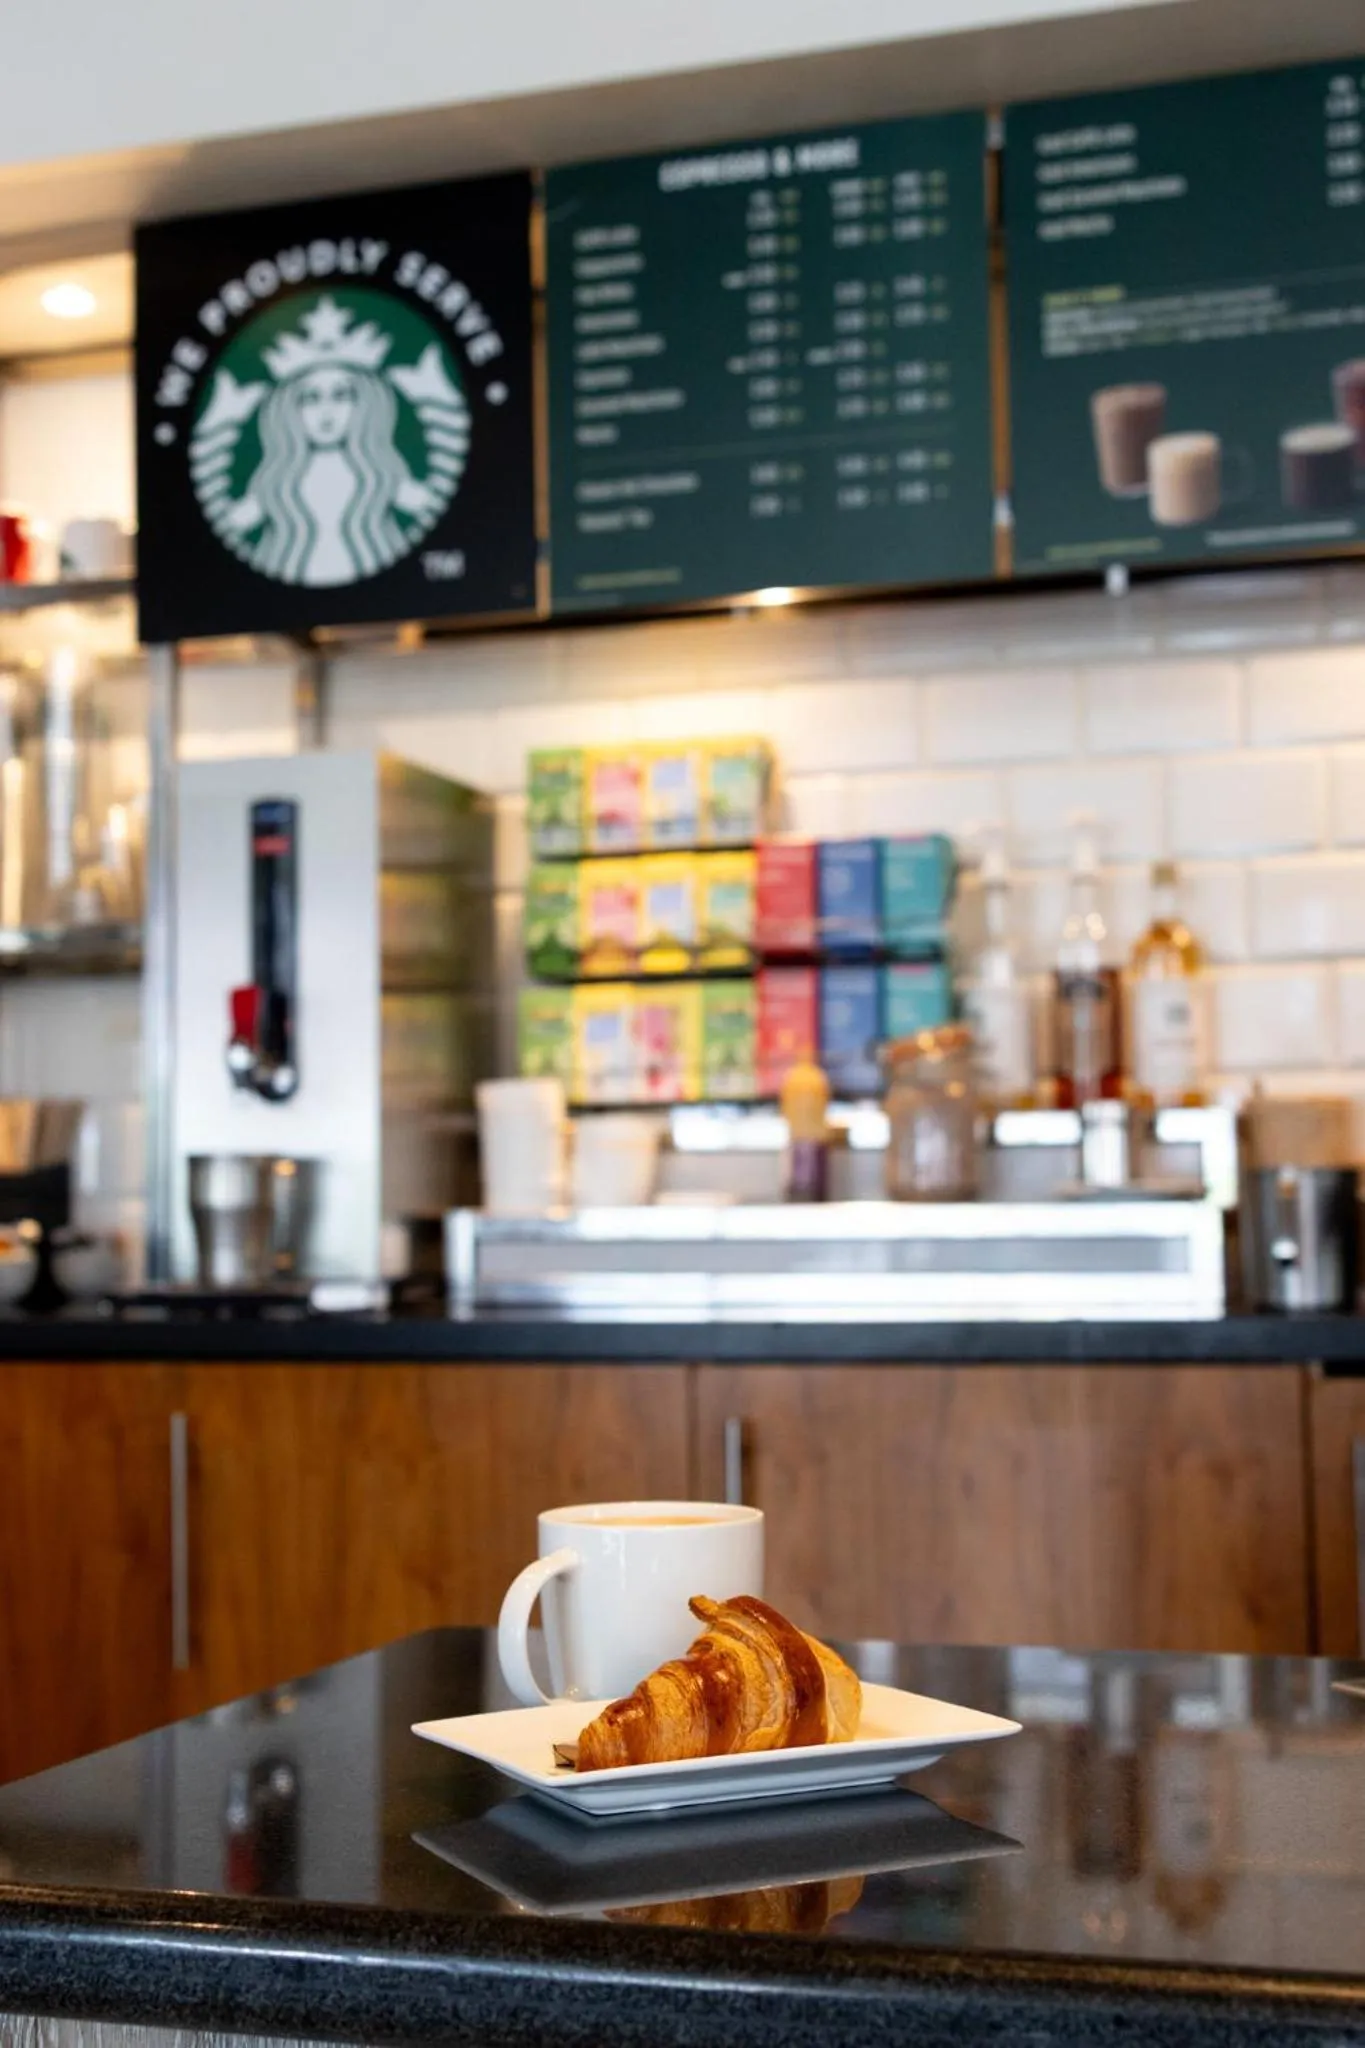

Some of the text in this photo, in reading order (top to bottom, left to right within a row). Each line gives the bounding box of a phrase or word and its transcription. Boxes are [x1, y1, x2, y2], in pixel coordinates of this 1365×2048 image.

[157, 239, 503, 406] WE PROUDLY SERVE
[421, 551, 464, 579] TM
